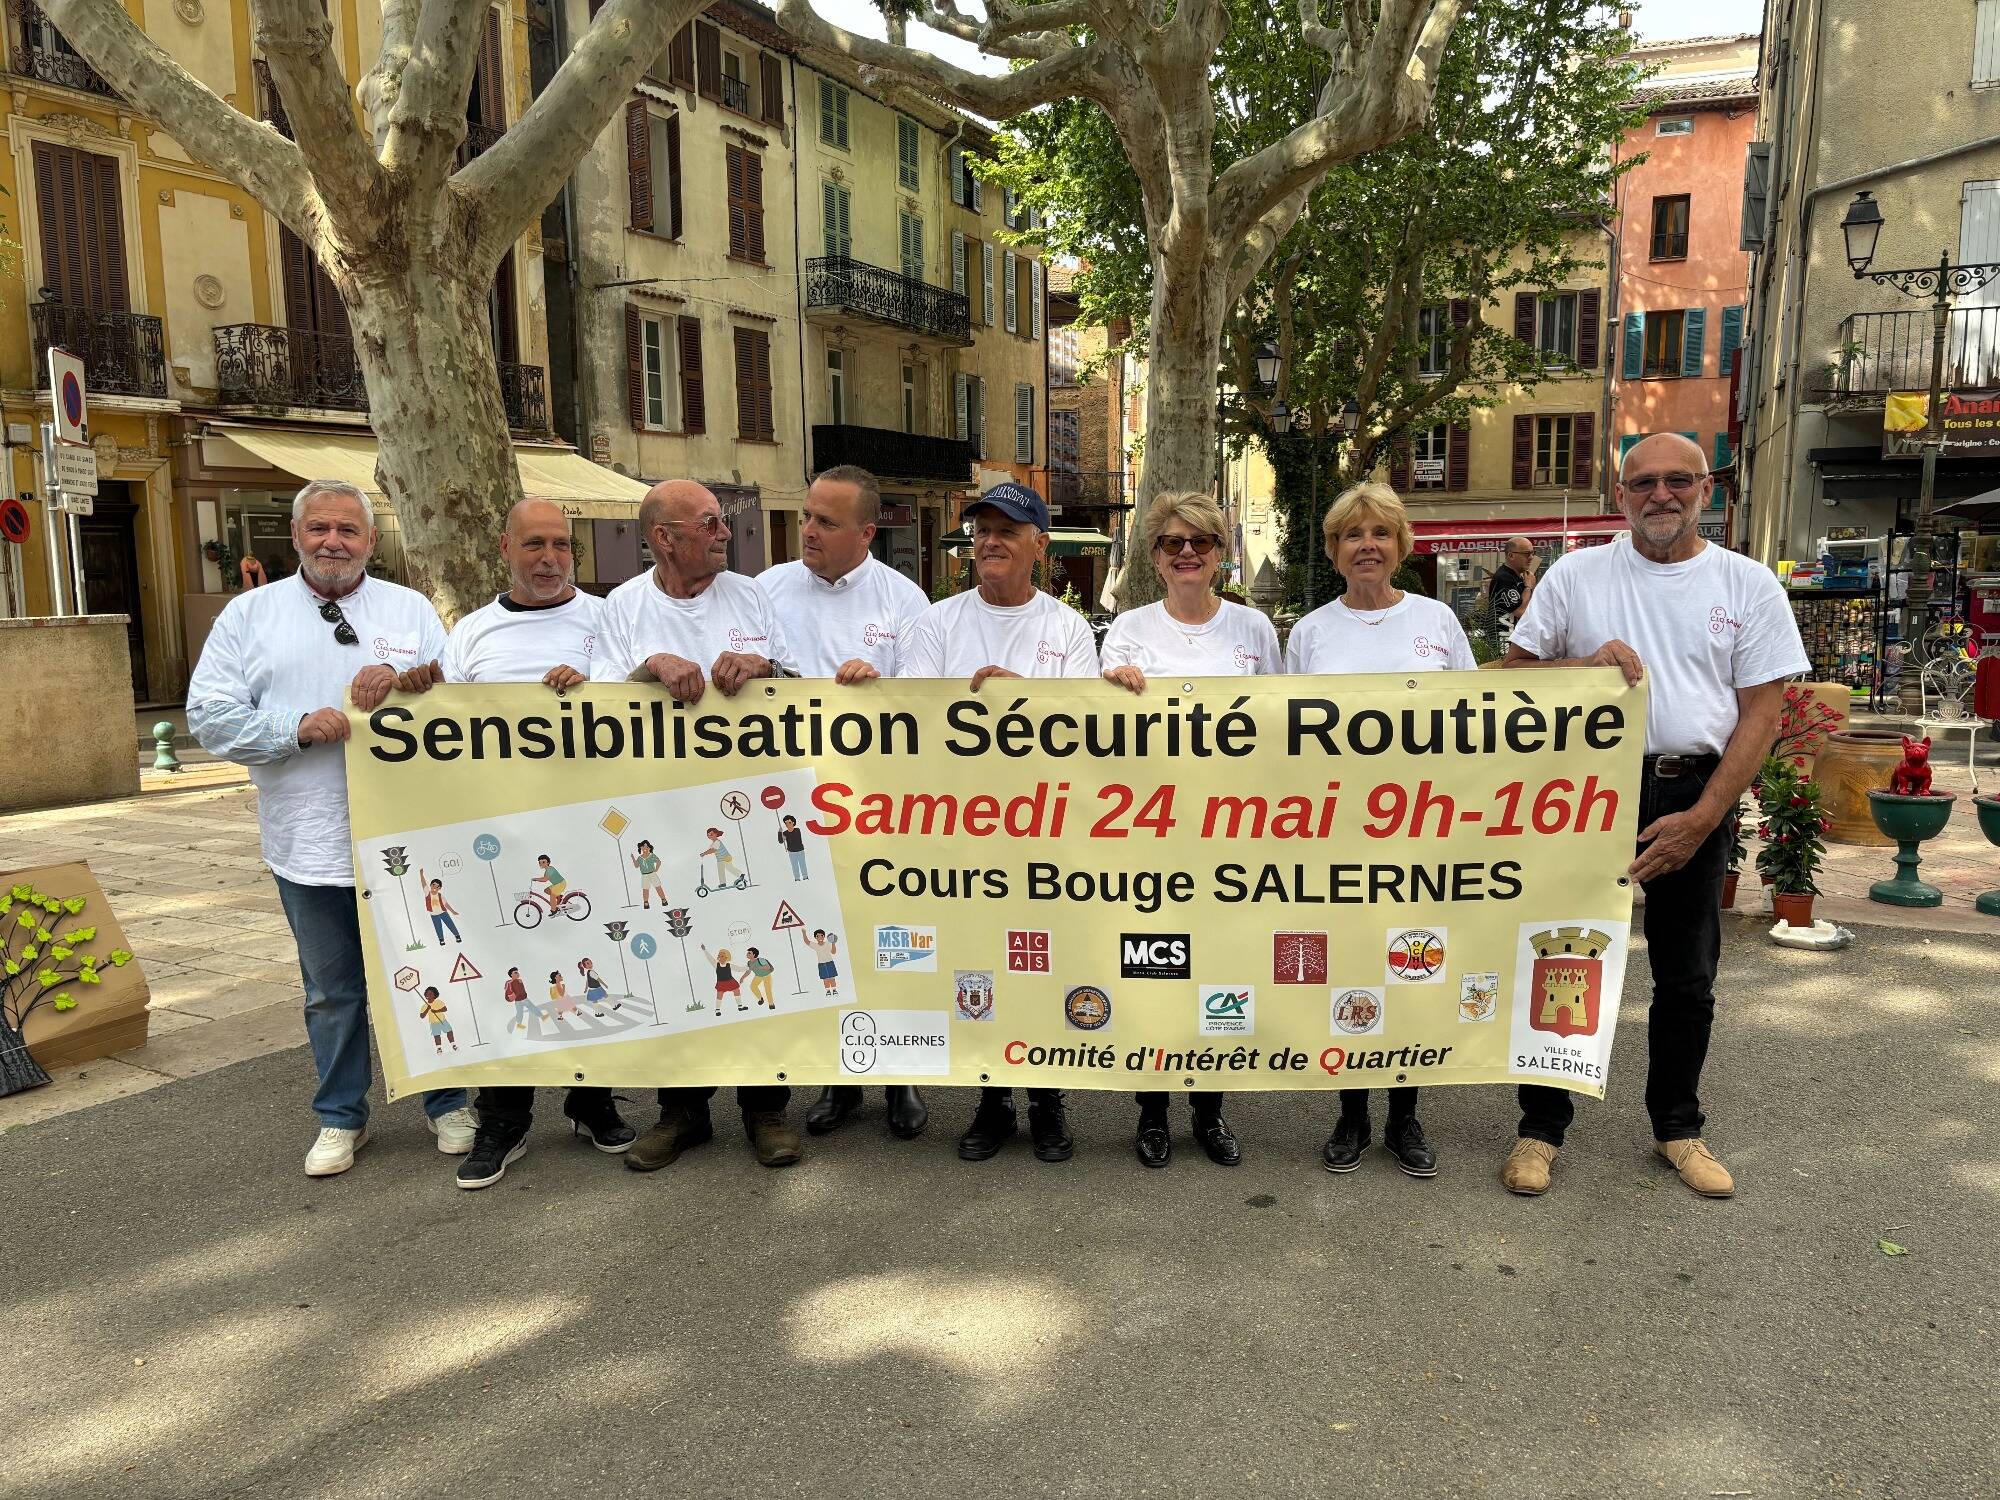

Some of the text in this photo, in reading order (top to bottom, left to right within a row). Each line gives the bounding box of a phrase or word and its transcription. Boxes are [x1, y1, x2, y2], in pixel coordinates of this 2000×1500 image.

[1943, 418, 1994, 429] Tous les
[721, 495, 758, 516] Coiffure
[878, 511, 894, 520] AOU
[1500, 588, 1521, 608] 19
[369, 691, 1625, 763] Sensibilisation Sécurité Routière
[805, 776, 1618, 839] Samedi 24 mai 9h-16h
[443, 858, 460, 868] GO!
[860, 859, 1523, 914] Cours Bouge SALERNES
[878, 931, 933, 949] MSRVar
[1014, 936, 1043, 948] A C
[1124, 940, 1187, 966] MCS
[1014, 956, 1043, 968] A S
[399, 972, 414, 986] STOP
[1336, 1004, 1378, 1021] LRS
[852, 1016, 865, 1031] C
[845, 1035, 945, 1048] C.I.Q. SALERNES
[852, 1050, 866, 1066] Q
[1004, 1040, 1453, 1076] Comité d'Intérêt de Quartier
[1544, 1046, 1582, 1057] VILLE DE
[1516, 1054, 1601, 1079] SALERNES
